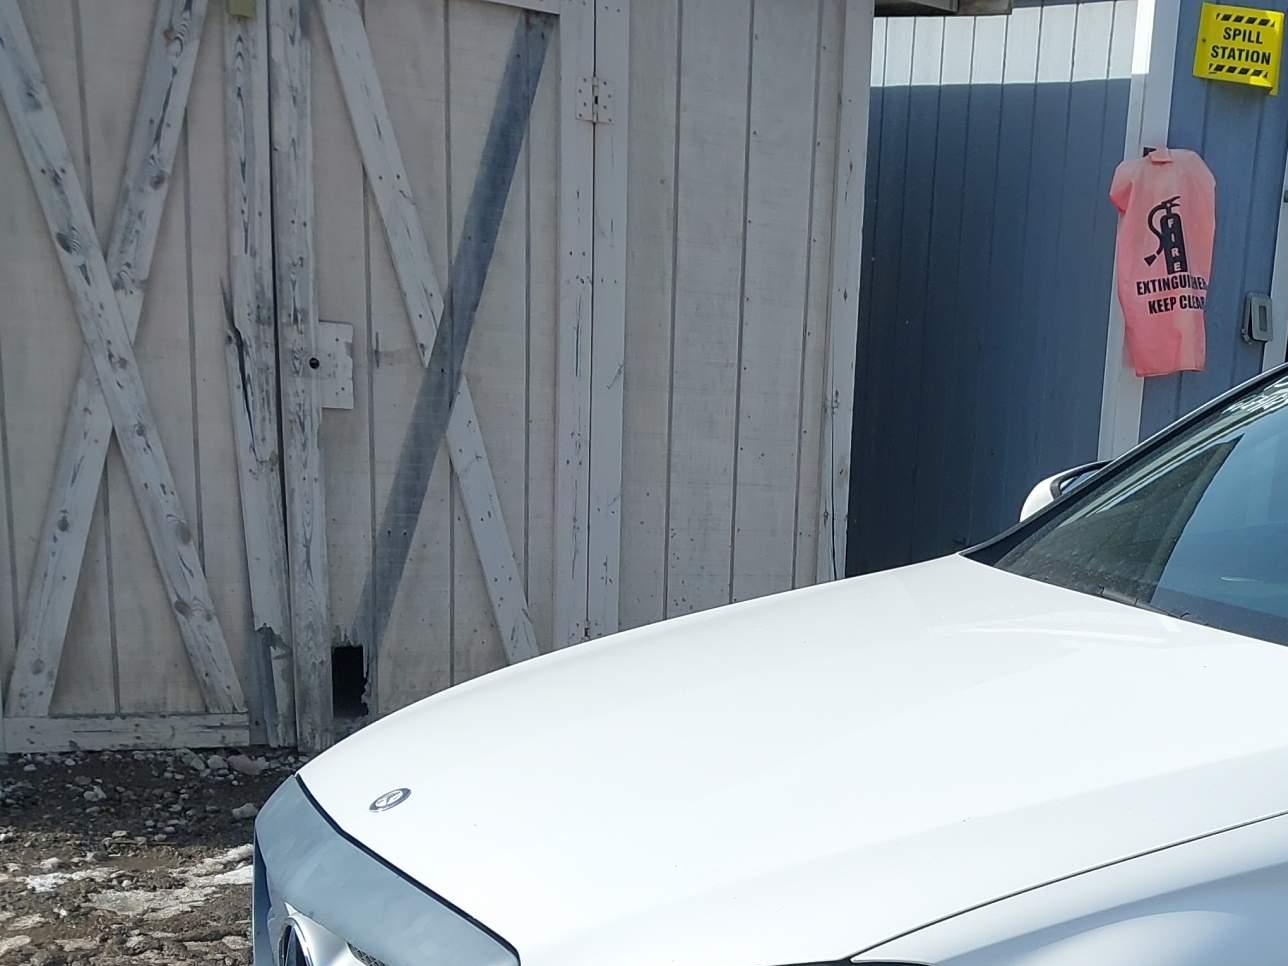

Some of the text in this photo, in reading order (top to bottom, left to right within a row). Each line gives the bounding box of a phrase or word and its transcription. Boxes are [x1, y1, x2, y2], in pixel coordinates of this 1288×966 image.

[1223, 27, 1263, 44] SPILL
[1210, 45, 1271, 65] STATION
[1167, 218, 1182, 272] FIRE
[1148, 296, 1177, 314] KEEP
